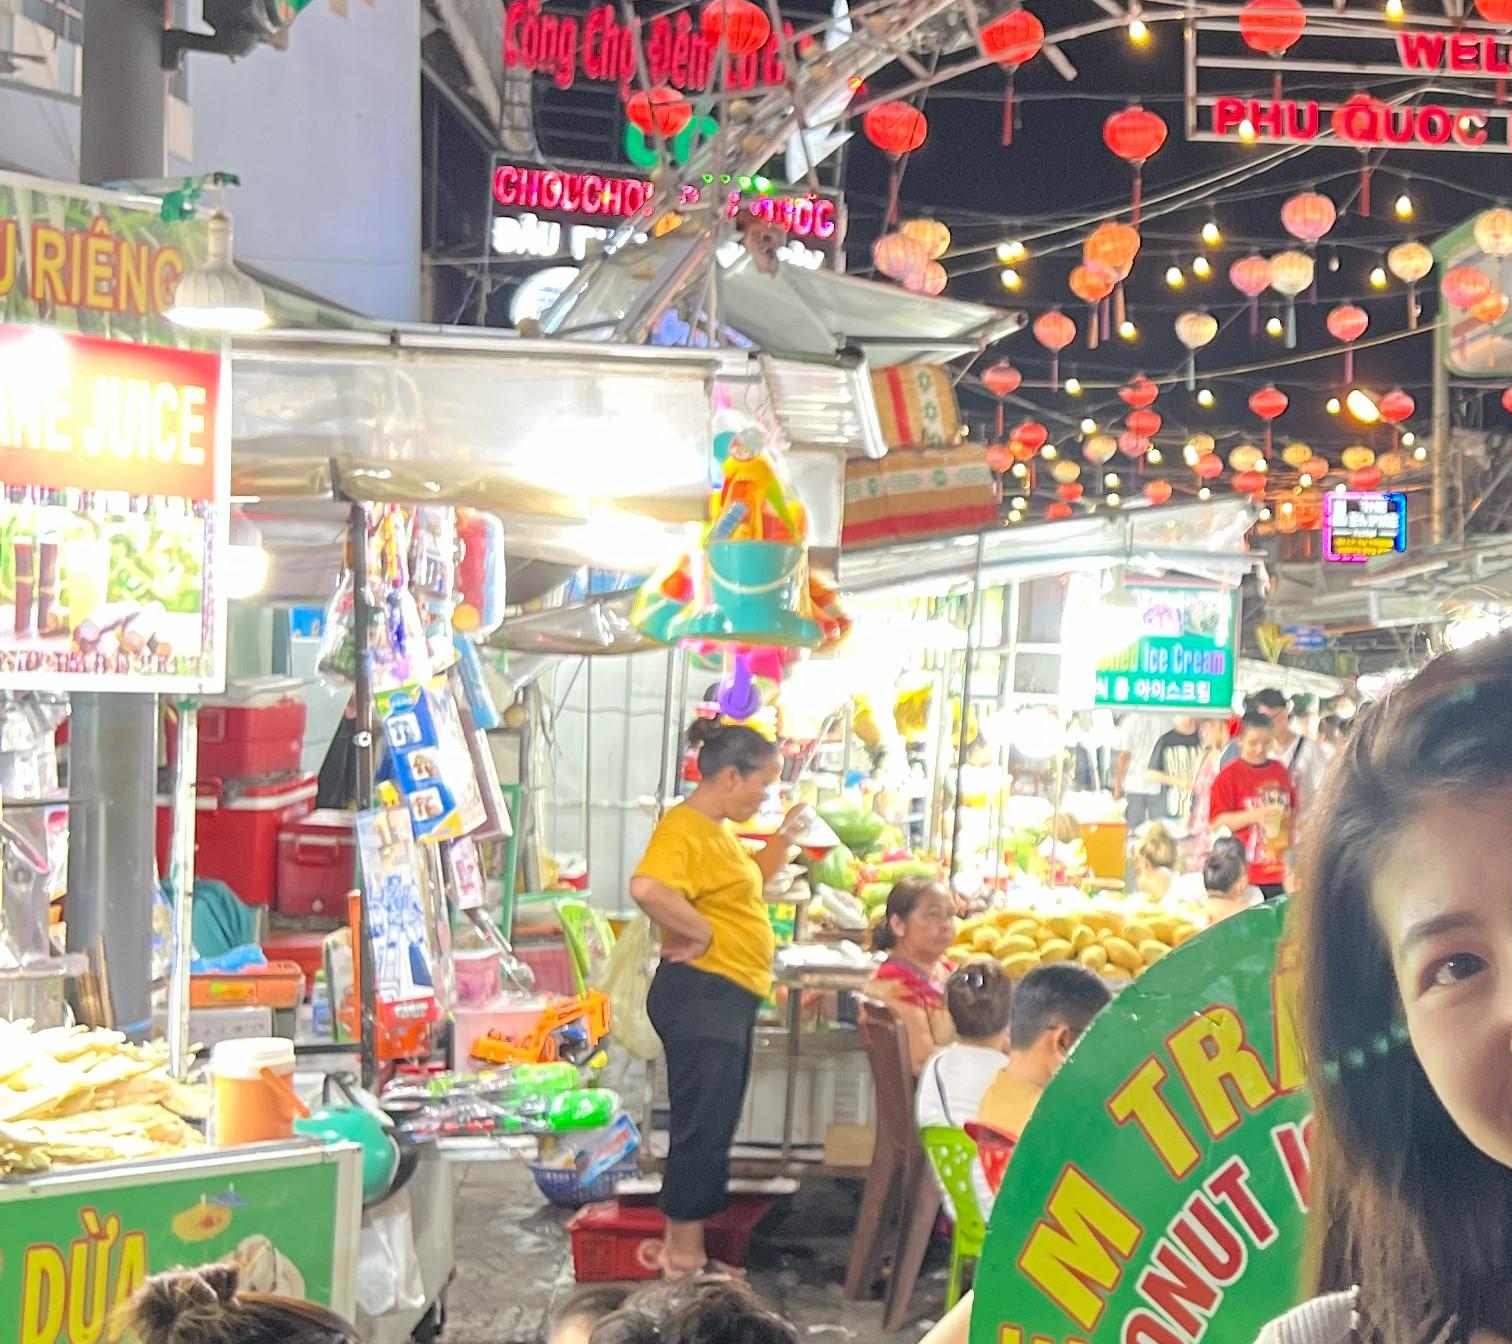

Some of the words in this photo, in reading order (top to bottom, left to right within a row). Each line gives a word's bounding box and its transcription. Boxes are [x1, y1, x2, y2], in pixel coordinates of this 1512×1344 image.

[1213, 96, 1319, 141] PHU
[1341, 102, 1489, 147] QUOC
[31, 214, 184, 316] RIÊNG
[82, 374, 208, 466] JUICE
[1142, 641, 1169, 675] Ice
[1172, 642, 1226, 676] Cream
